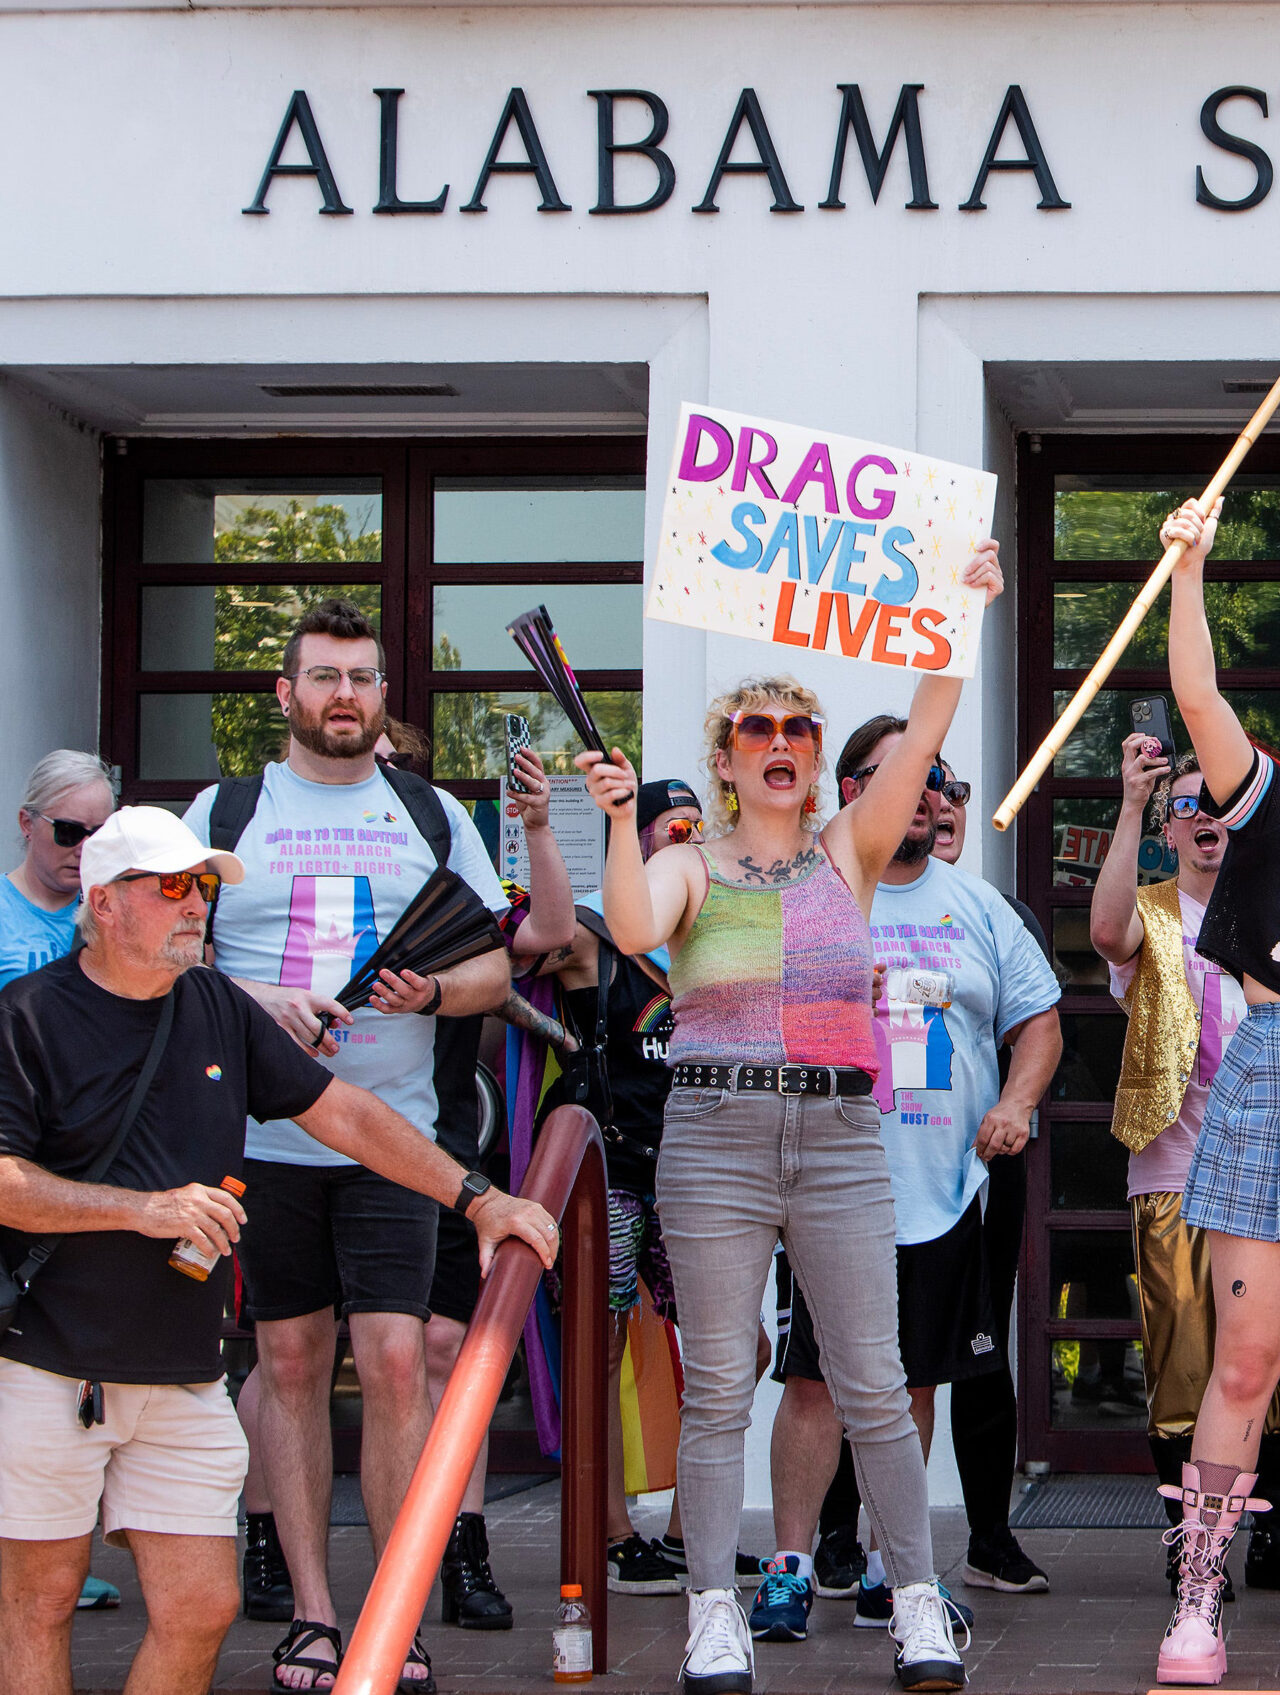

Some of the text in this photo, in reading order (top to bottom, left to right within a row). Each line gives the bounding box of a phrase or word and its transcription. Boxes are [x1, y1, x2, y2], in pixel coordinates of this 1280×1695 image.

[241, 83, 1072, 216] ALABAMA
[678, 413, 898, 520] DRAG
[710, 502, 919, 606] SAVES
[772, 581, 952, 670] LIVES
[314, 828, 330, 841] TO
[333, 828, 354, 841] THE
[280, 843, 392, 857] ALABAMA MARCH
[270, 861, 401, 876] FOR LGBTQ+ RIGHTS
[881, 925, 895, 938] TO
[896, 924, 917, 938] THE
[874, 940, 951, 953] BAMA MARCH
[919, 956, 961, 969] RIGHTS
[1188, 960, 1205, 971] FOR
[900, 1091, 914, 1101] THE
[900, 1102, 923, 1112] SHOW
[900, 1112, 929, 1125] MUST
